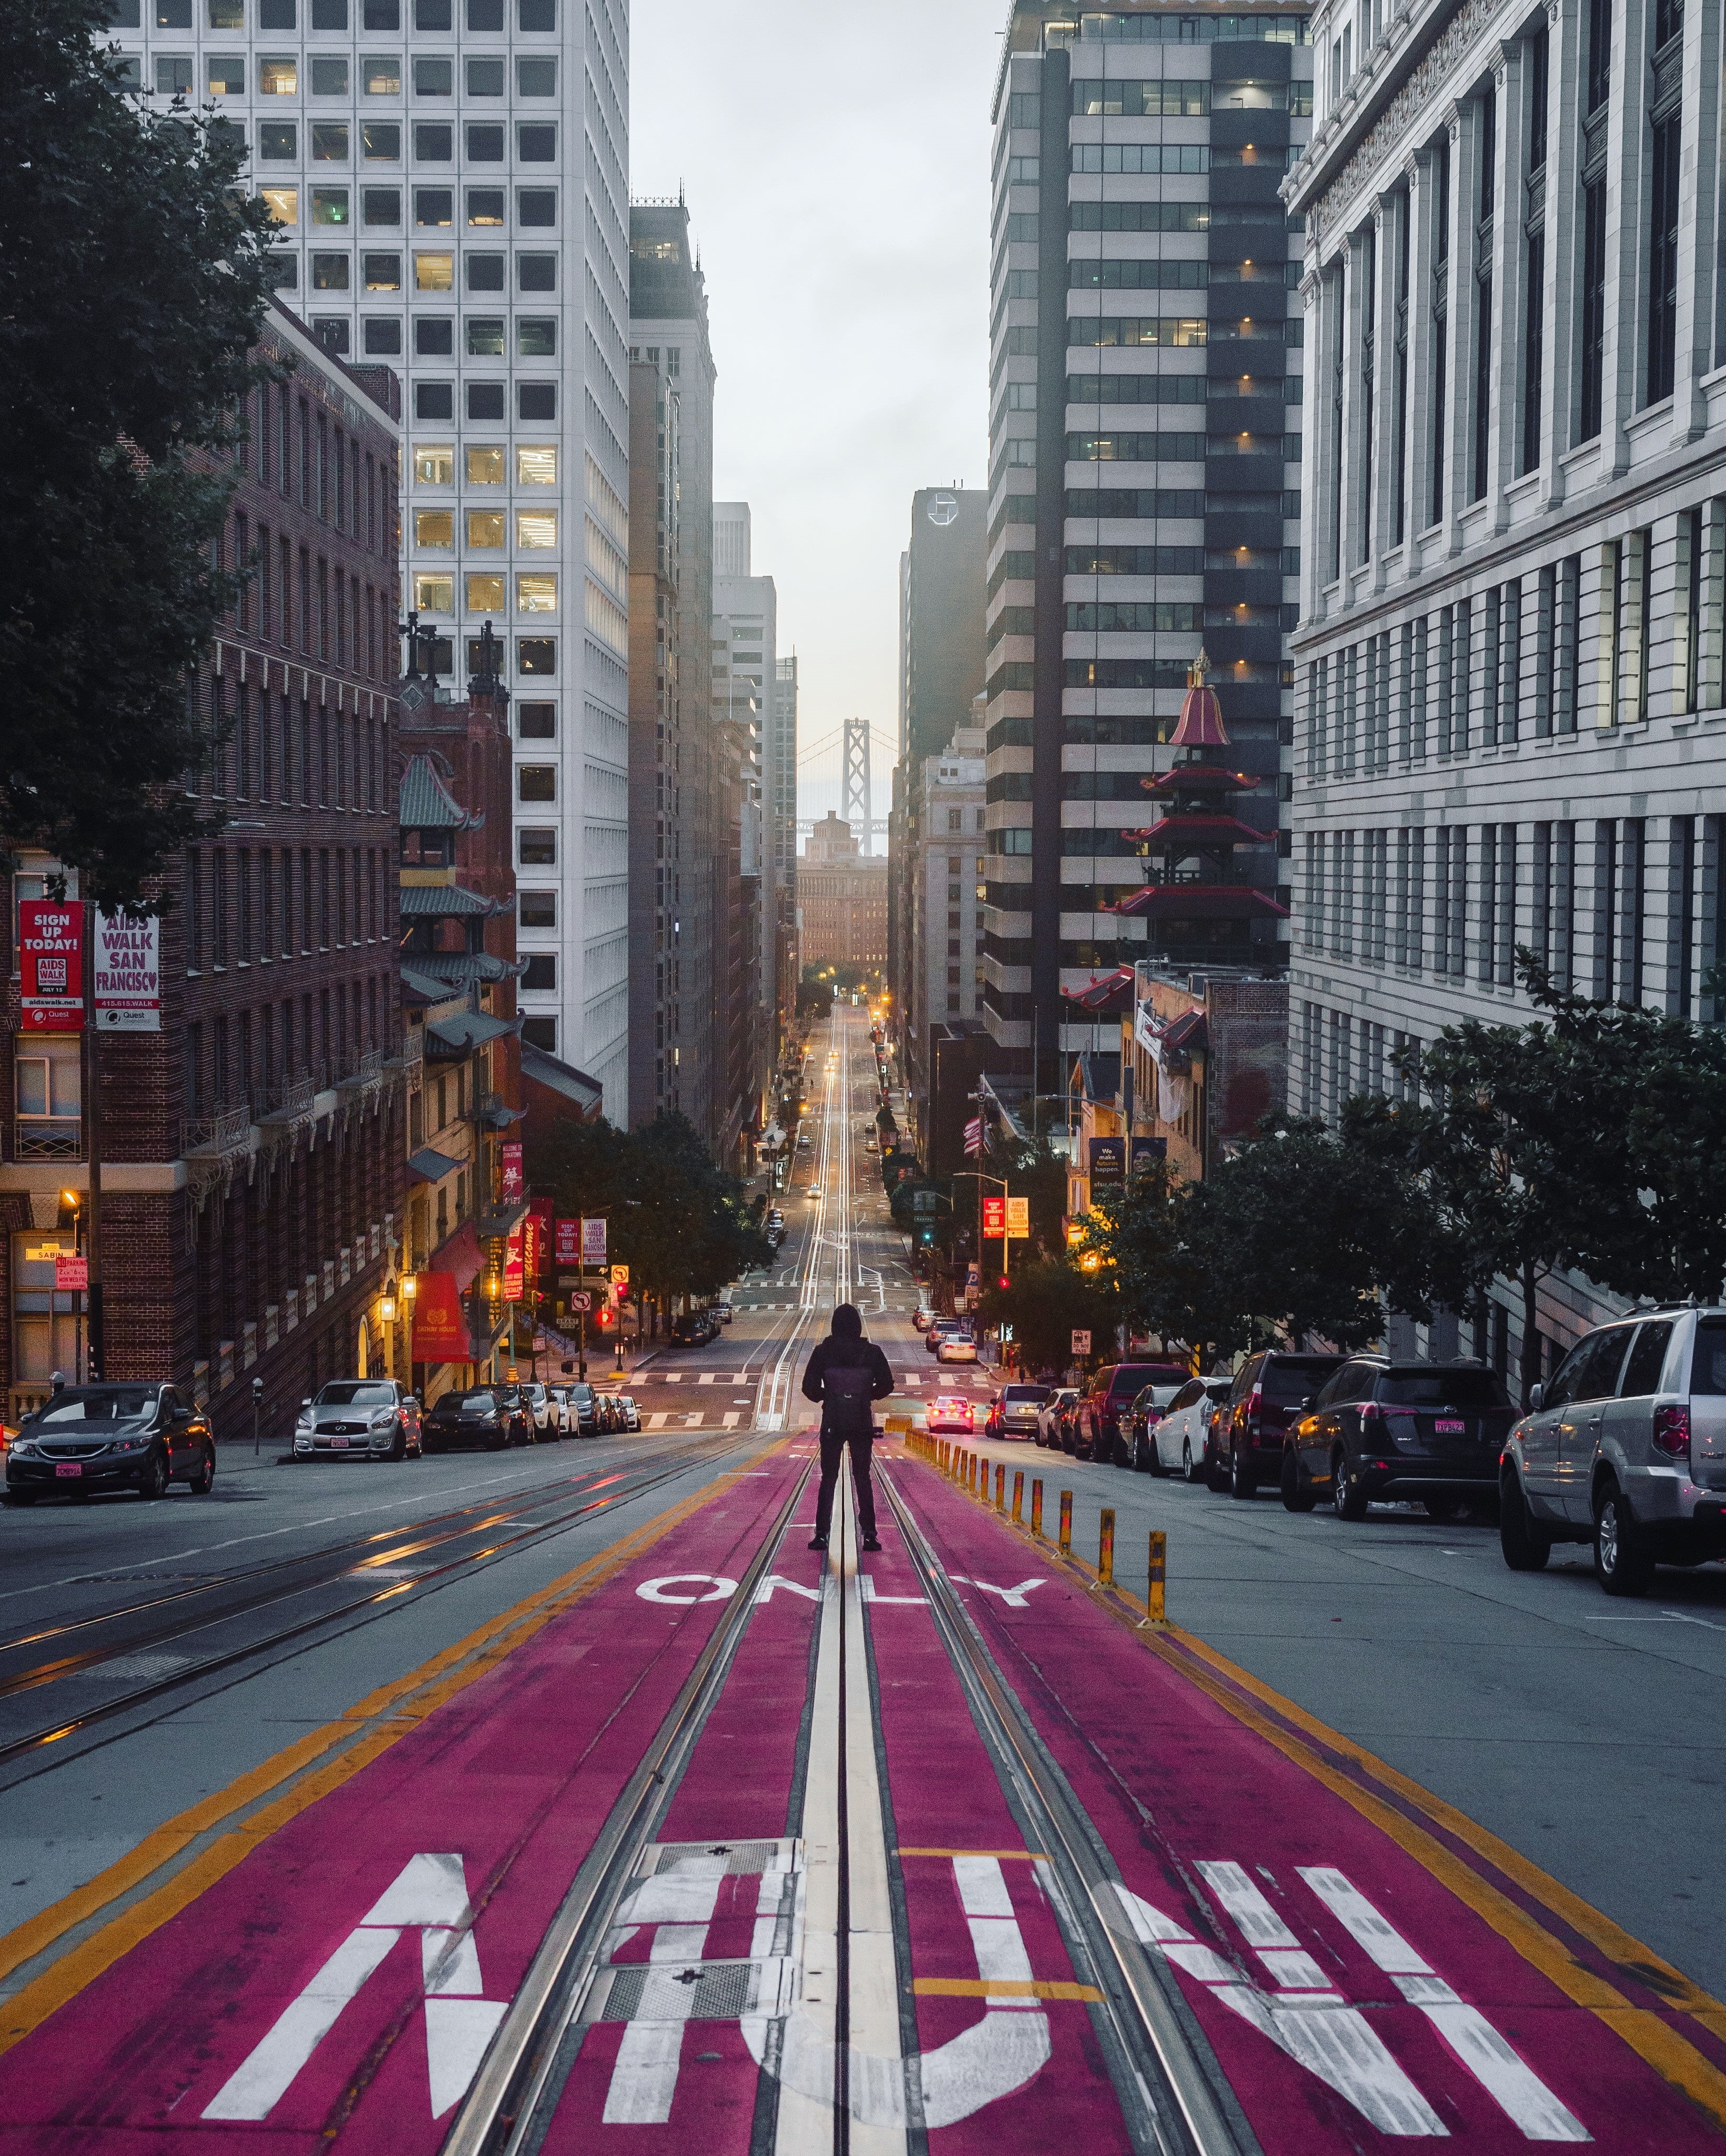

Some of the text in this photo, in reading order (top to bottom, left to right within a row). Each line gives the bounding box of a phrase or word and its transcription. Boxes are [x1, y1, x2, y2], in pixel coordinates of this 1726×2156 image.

[34, 915, 69, 925] SIGN
[42, 927, 62, 937] UP
[24, 939, 77, 950] TODAY!
[102, 933, 153, 950] WALK
[39, 960, 65, 970] AIDS
[109, 952, 145, 969] SAN
[39, 971, 65, 979] WALK
[57, 1258, 65, 1266] NO
[967, 1273, 977, 1284] P
[635, 1574, 1048, 1607] ONLY
